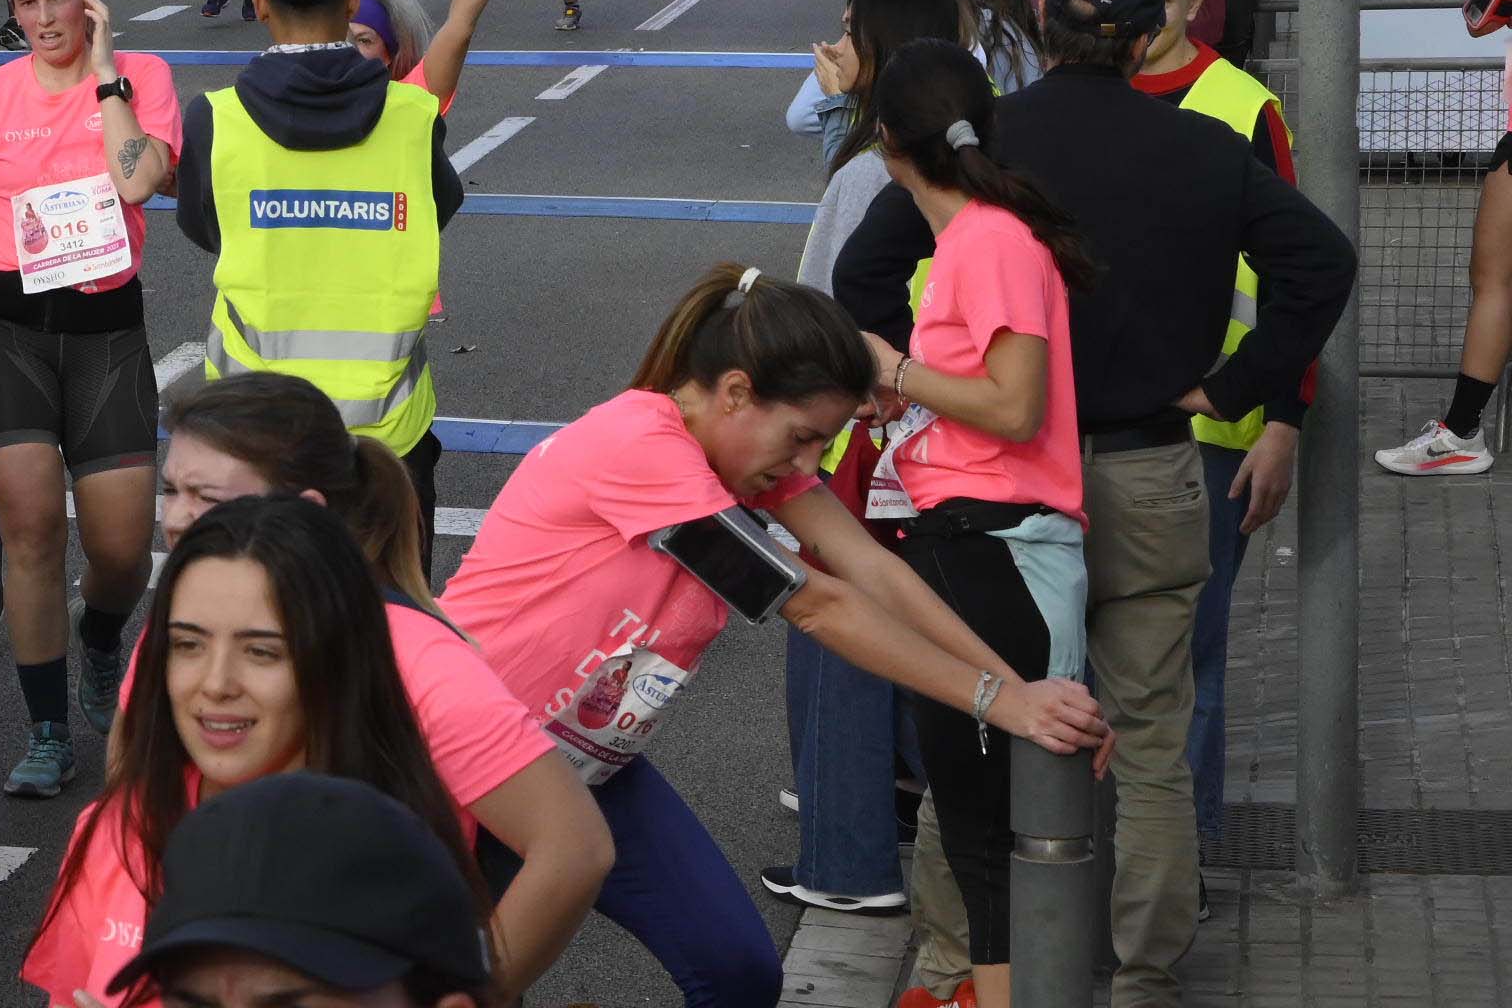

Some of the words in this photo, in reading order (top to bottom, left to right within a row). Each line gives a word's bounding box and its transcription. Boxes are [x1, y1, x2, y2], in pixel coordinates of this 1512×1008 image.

[5, 126, 52, 142] OYSHO
[42, 199, 87, 216] ASTURIANA
[253, 200, 390, 221] VOLUNTARIS
[397, 193, 405, 230] 2000
[50, 219, 89, 240] 016
[59, 239, 85, 251] 3412
[33, 257, 62, 270] CARRERA
[33, 271, 65, 285] OYSHO
[638, 678, 674, 704] ASTUR
